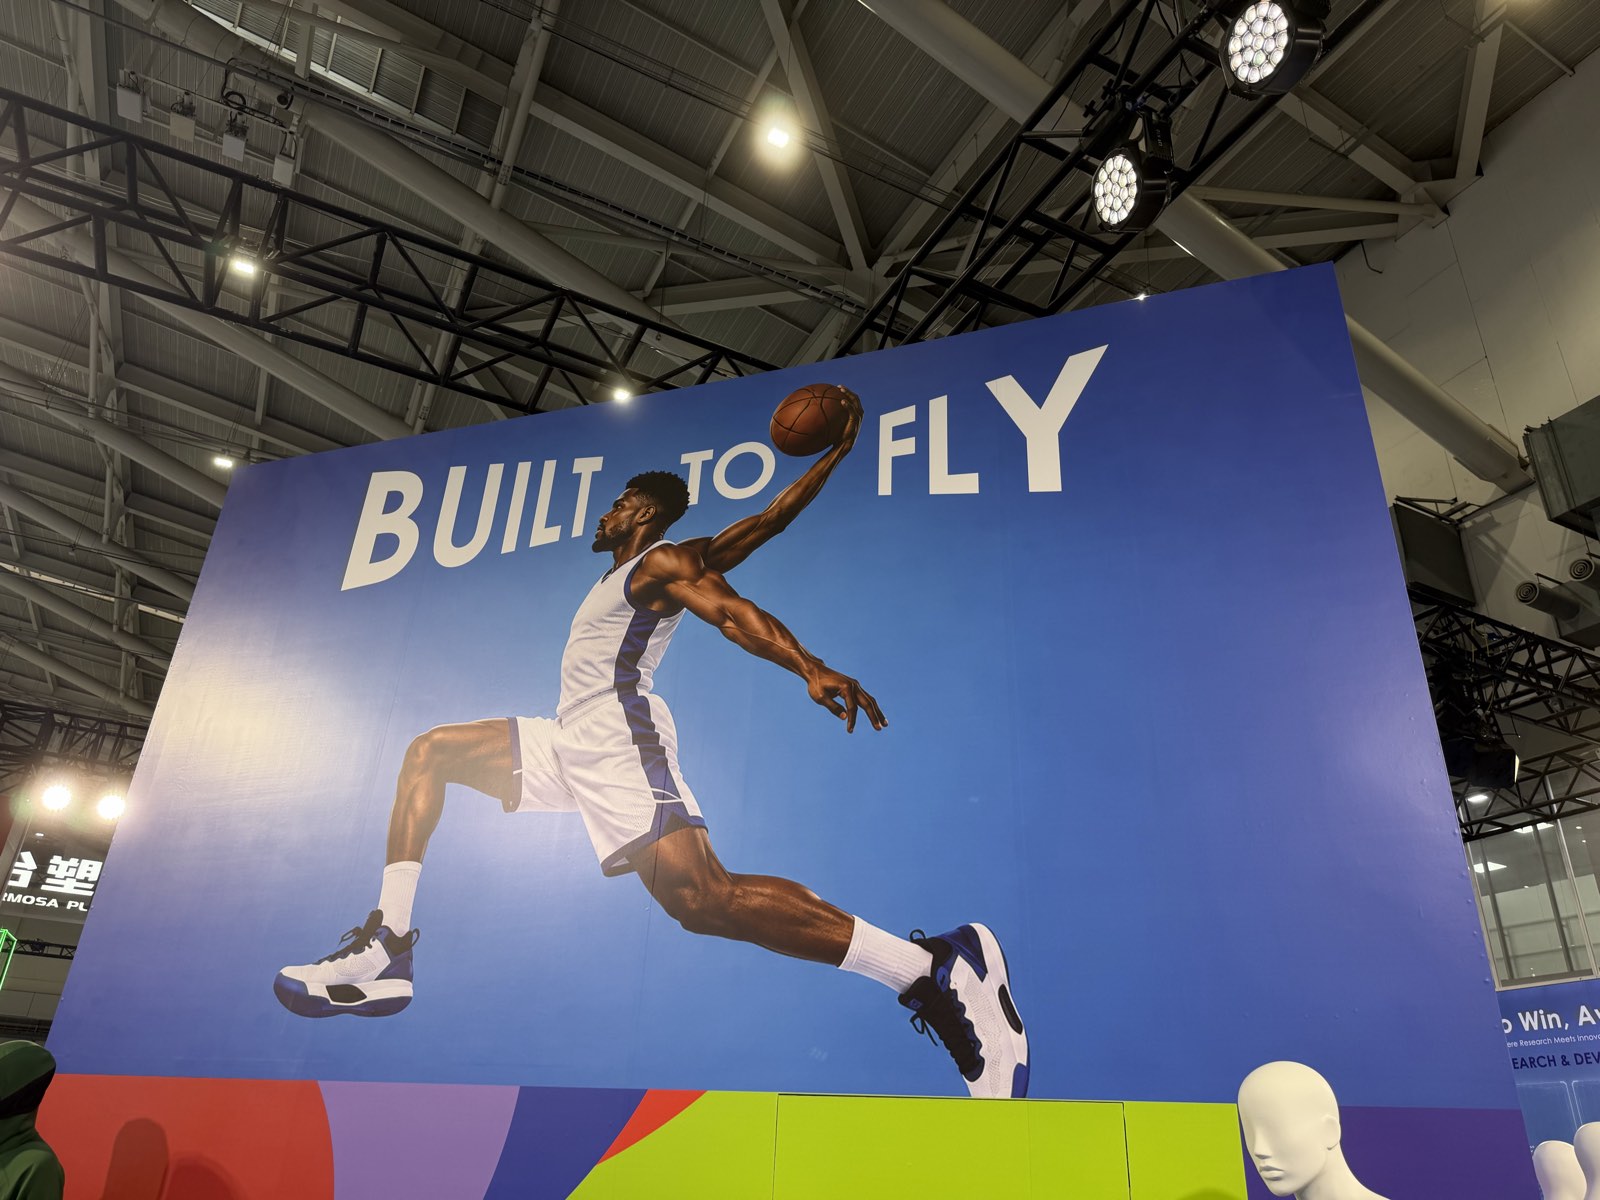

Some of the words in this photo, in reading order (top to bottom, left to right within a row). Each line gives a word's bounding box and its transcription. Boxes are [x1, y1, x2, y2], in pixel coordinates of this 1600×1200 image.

[340, 455, 604, 592] BUILT
[680, 441, 776, 507] TO
[877, 344, 1109, 496] FLY
[66, 900, 88, 912] PL
[1517, 1009, 1569, 1032] Win,
[1519, 1037, 1553, 1047] Research
[1553, 1035, 1576, 1044] Meets
[1560, 1054, 1571, 1067] &
